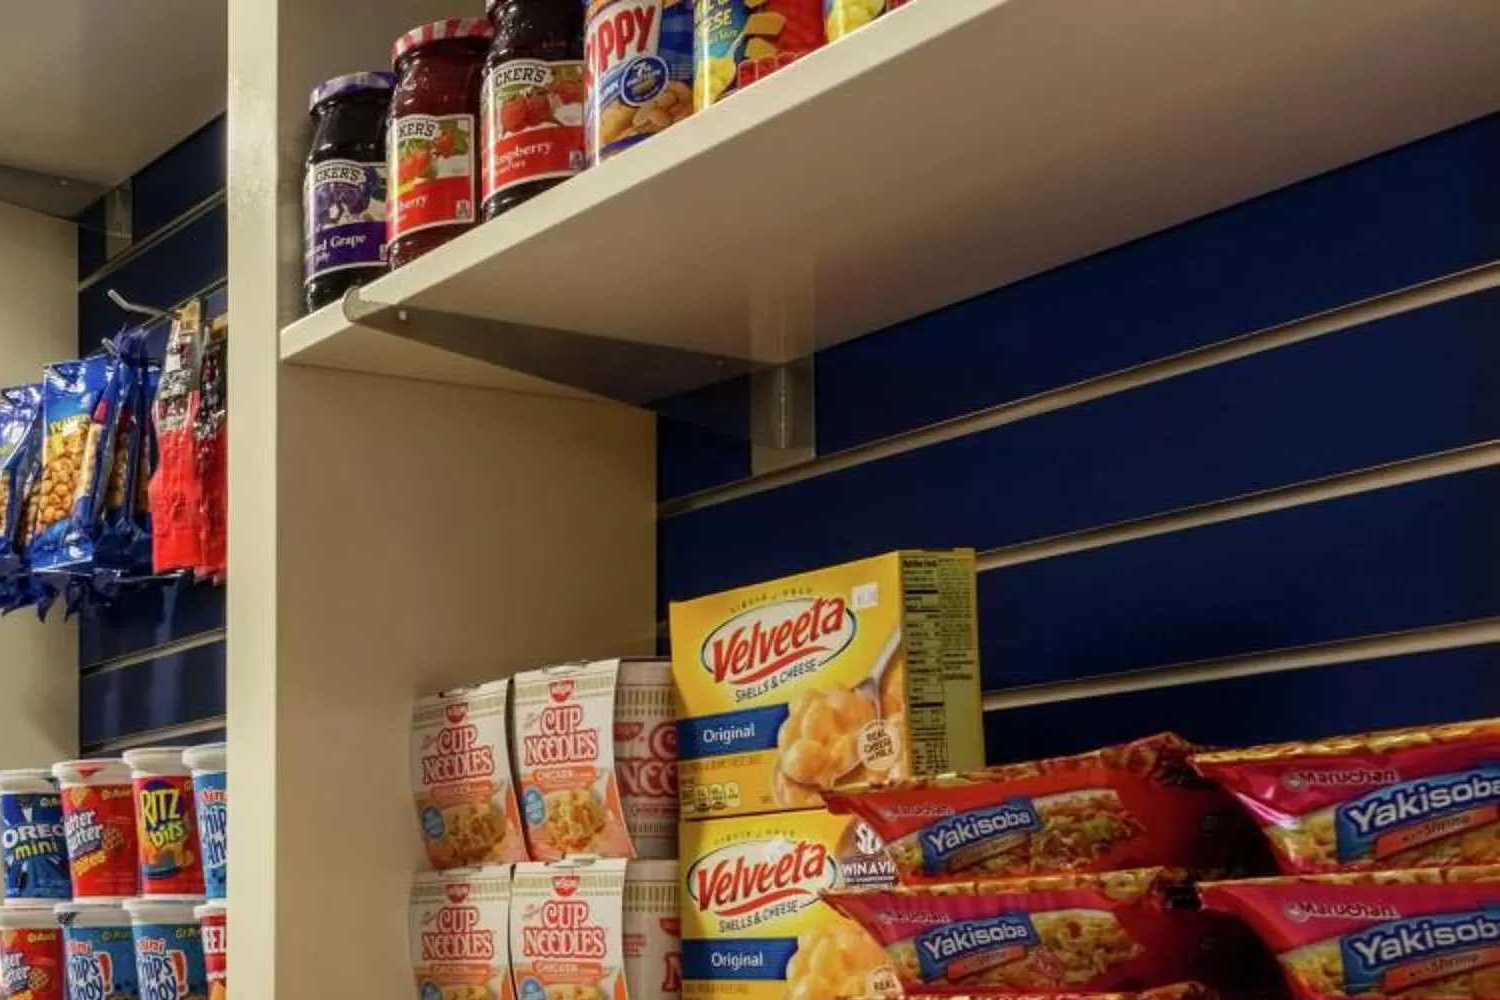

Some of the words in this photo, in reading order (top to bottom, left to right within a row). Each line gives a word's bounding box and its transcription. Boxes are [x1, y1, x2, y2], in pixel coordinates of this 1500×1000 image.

[712, 597, 845, 684] Velveeta
[735, 680, 769, 703] SHELLS
[779, 659, 817, 683] CHEESE
[540, 705, 583, 735] CUP
[703, 724, 755, 746] Original
[438, 725, 477, 751] CUP
[524, 729, 598, 766] NOODLES
[423, 746, 494, 783] NOODLES
[139, 788, 181, 829] RITZ
[930, 809, 1031, 853] Yakisoba
[698, 840, 827, 912] Velveeta
[438, 907, 479, 932] CUP
[543, 901, 589, 929] CUP
[718, 911, 753, 932] SHELLS
[762, 899, 799, 921] CHEESE
[423, 930, 494, 960] NOODLES
[523, 927, 606, 958] NOODLES
[924, 924, 1028, 960] Yakisoba
[1354, 919, 1500, 967] Yakisob
[711, 952, 764, 972] Original
